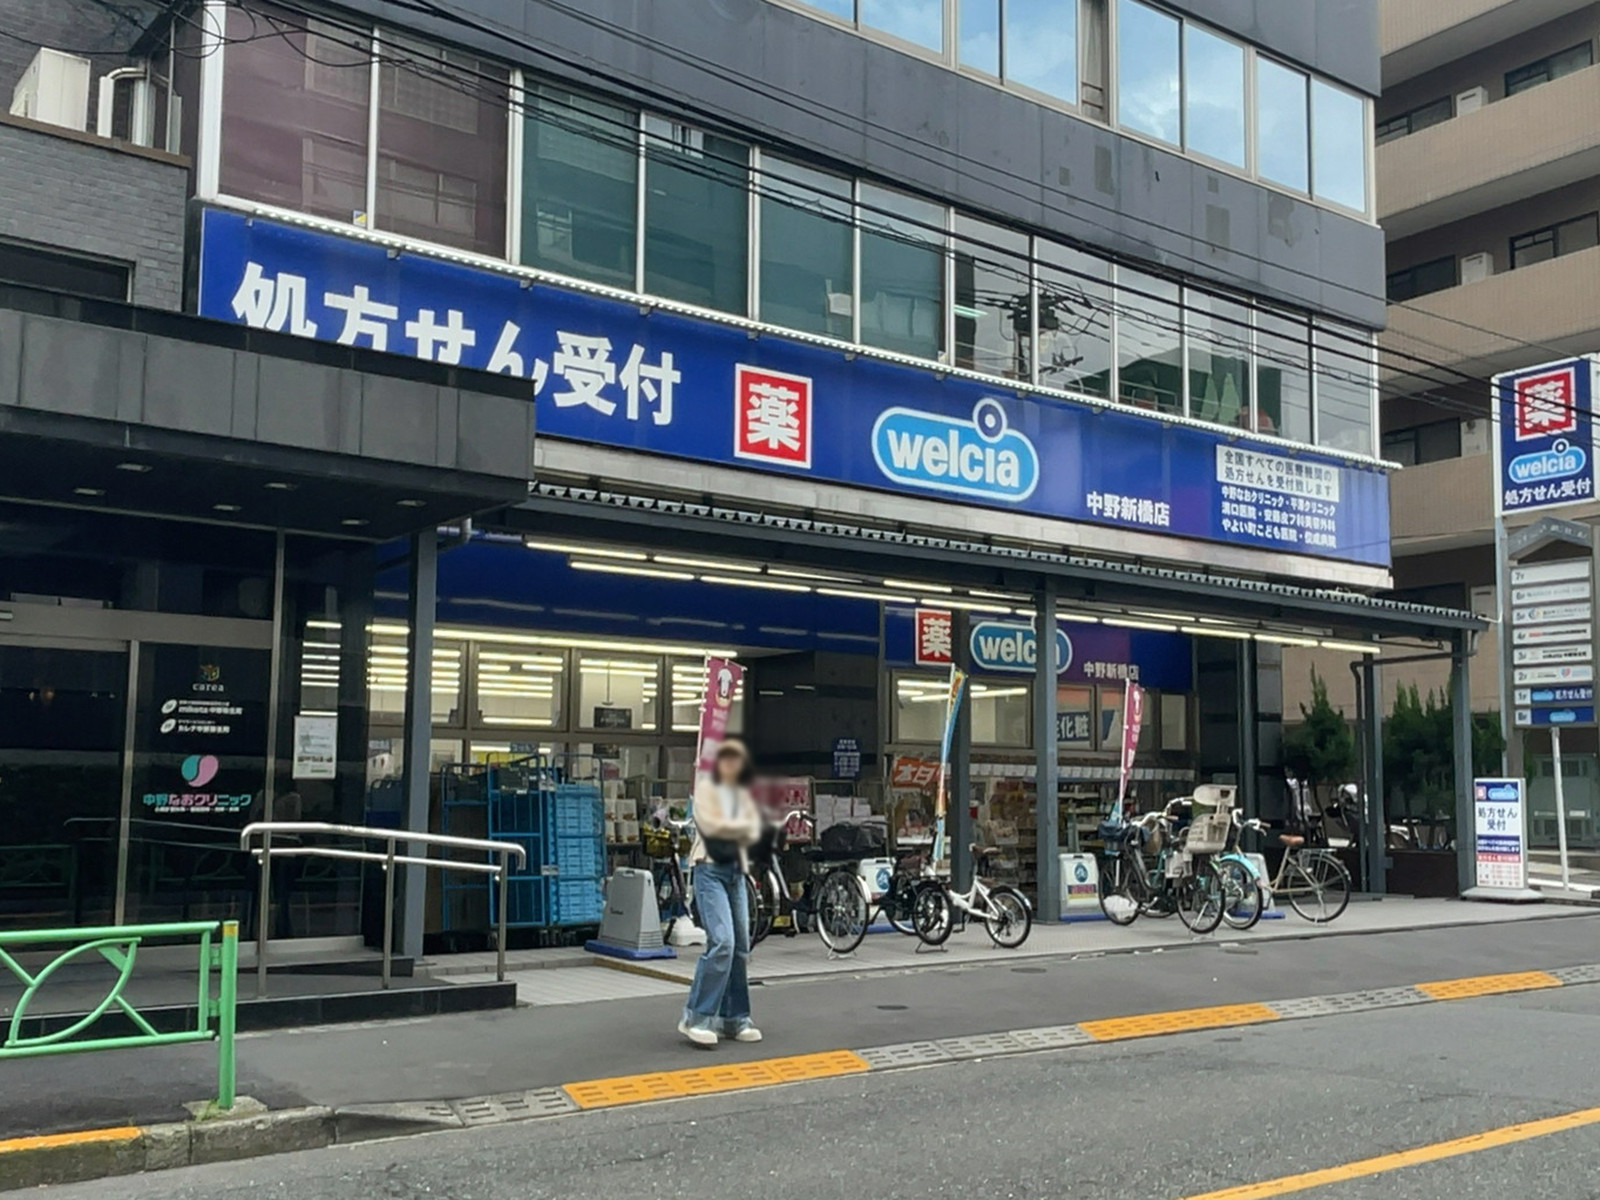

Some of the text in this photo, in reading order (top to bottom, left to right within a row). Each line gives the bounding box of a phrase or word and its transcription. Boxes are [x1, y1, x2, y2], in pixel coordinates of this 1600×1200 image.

[231, 262, 681, 425] 処方せん受付
[1524, 381, 1566, 429] 薬
[747, 382, 801, 452] 薬
[887, 428, 1021, 488] welcia
[1515, 456, 1576, 478] welcia
[1505, 477, 1591, 505] 処方せん受付
[1087, 492, 1170, 526] 中野新橋店
[922, 616, 951, 657] 薬
[1084, 661, 1139, 680] 中野新橋店
[193, 683, 224, 692] carea
[1057, 715, 1089, 738] 化粧
[894, 763, 941, 786] 本日
[143, 793, 251, 807] 中野なおクリニック
[1478, 807, 1517, 819] 処方せん
[1487, 820, 1506, 831] 受付
